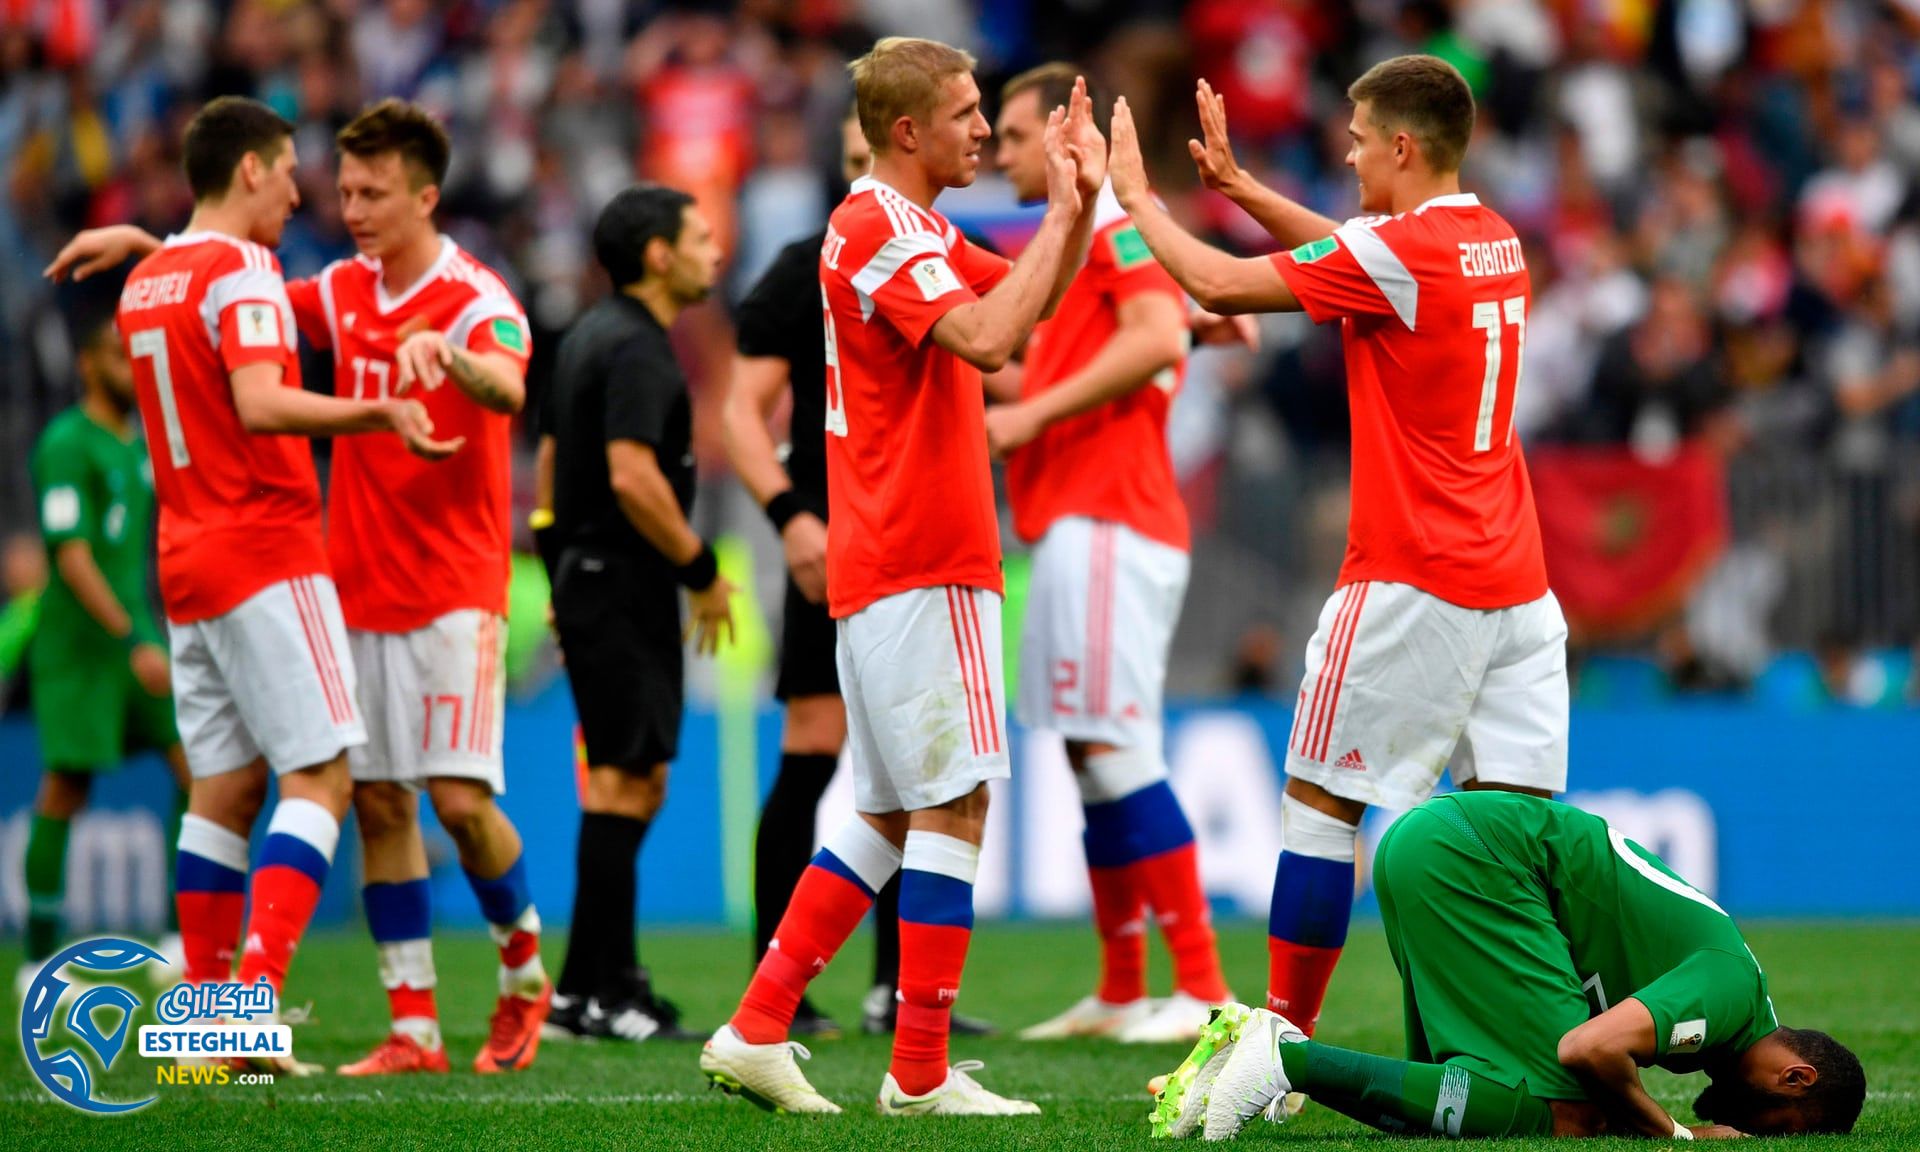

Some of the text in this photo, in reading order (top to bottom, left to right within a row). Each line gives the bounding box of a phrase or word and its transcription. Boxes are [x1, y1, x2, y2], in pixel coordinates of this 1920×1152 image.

[1458, 236, 1526, 277] ZOBNIN
[422, 694, 464, 752] 17
[1333, 759, 1367, 772] adidas
